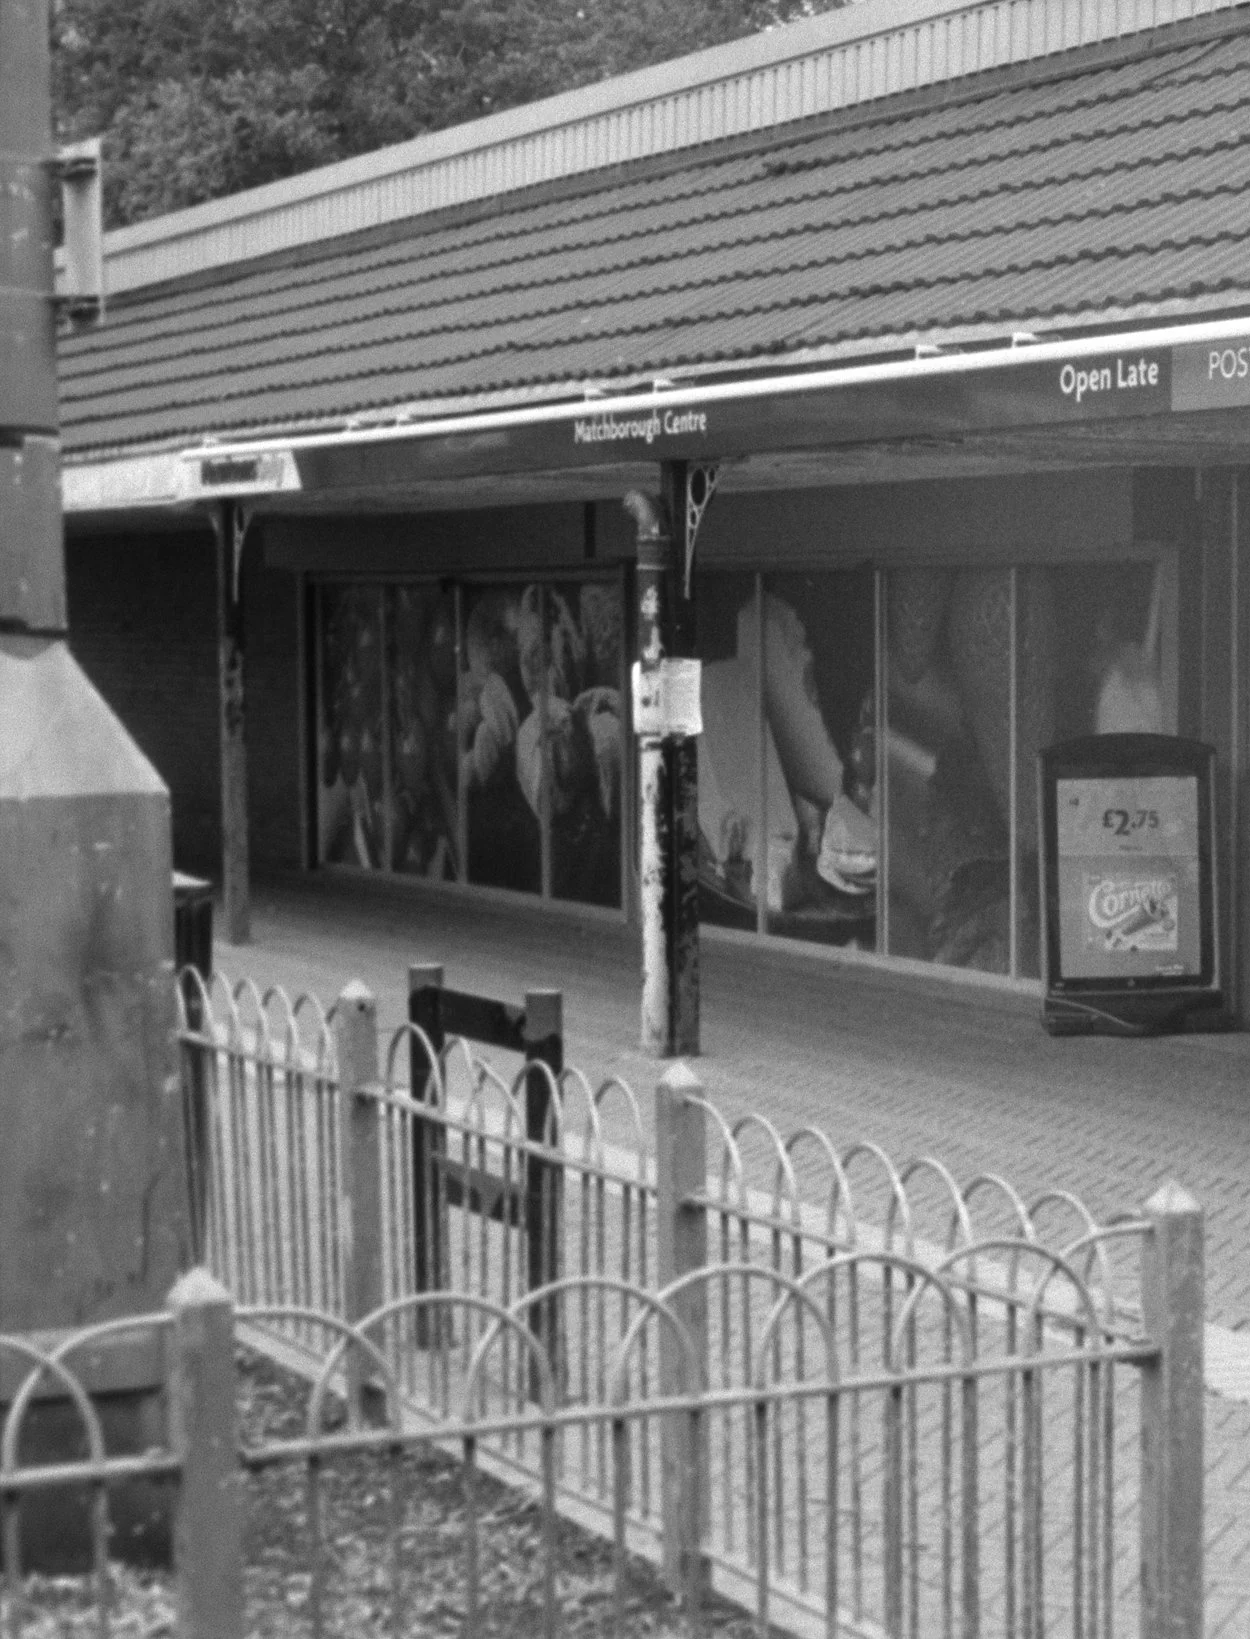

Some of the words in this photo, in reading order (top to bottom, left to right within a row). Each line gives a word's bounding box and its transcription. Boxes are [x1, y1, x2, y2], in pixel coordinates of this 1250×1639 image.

[1060, 363, 1112, 402] Open
[1117, 358, 1160, 388] Late
[574, 409, 661, 444] Matchborough
[664, 408, 707, 435] Centre
[1101, 807, 1161, 836] £2.75
